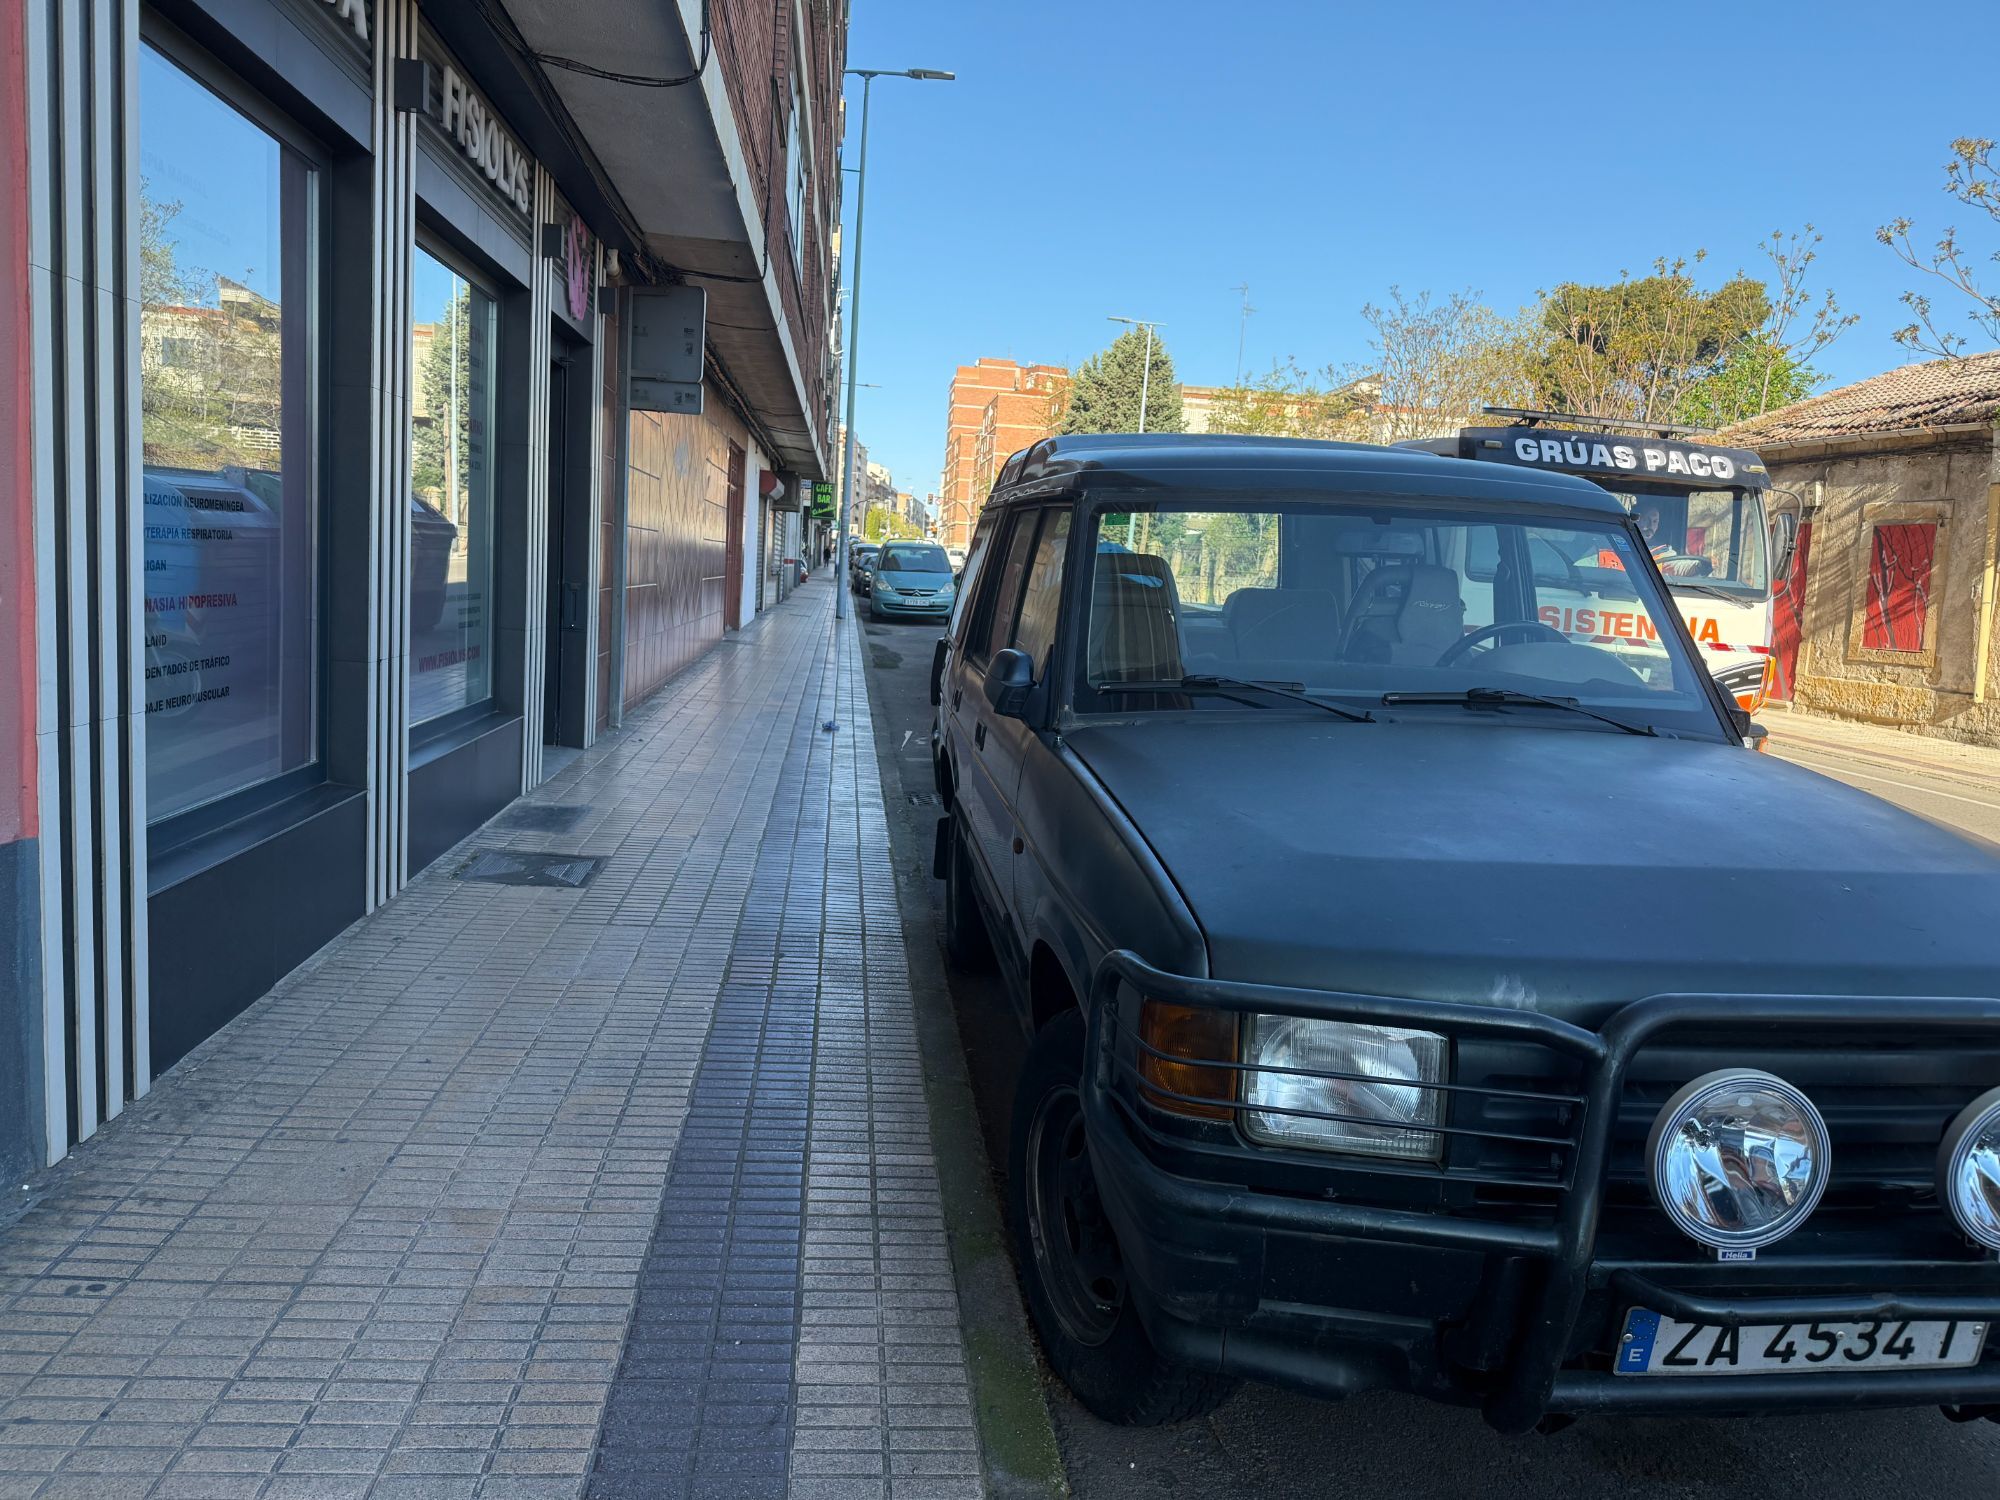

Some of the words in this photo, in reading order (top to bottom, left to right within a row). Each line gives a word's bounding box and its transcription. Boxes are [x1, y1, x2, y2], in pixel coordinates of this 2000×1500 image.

[442, 66, 529, 213] FISIOLYS
[1515, 436, 1637, 469] GRÚAS
[1643, 448, 1735, 479] PACO
[815, 483, 833, 493] CAFE
[144, 493, 182, 507] LIZACIÓN
[183, 496, 245, 512] NEUROMENÍNGEA
[817, 494, 831, 504] BAR
[144, 527, 179, 540] TERAPIA
[181, 528, 233, 541] RESPIRATORIA
[145, 598, 176, 612] NASIA
[178, 593, 238, 610] HIPOPRESIVA
[1538, 605, 1720, 643] SISTENIA
[145, 635, 167, 648] LAND
[145, 662, 187, 680] DENTADOS
[189, 660, 199, 671] DE
[200, 655, 230, 670] TRÁFICO
[145, 699, 164, 715] DAJE
[165, 686, 230, 710] NEUROMUSCULAR
[1662, 1319, 1740, 1366] ZA
[1763, 1321, 1915, 1364] 4534
[1628, 1348, 1644, 1362] E
